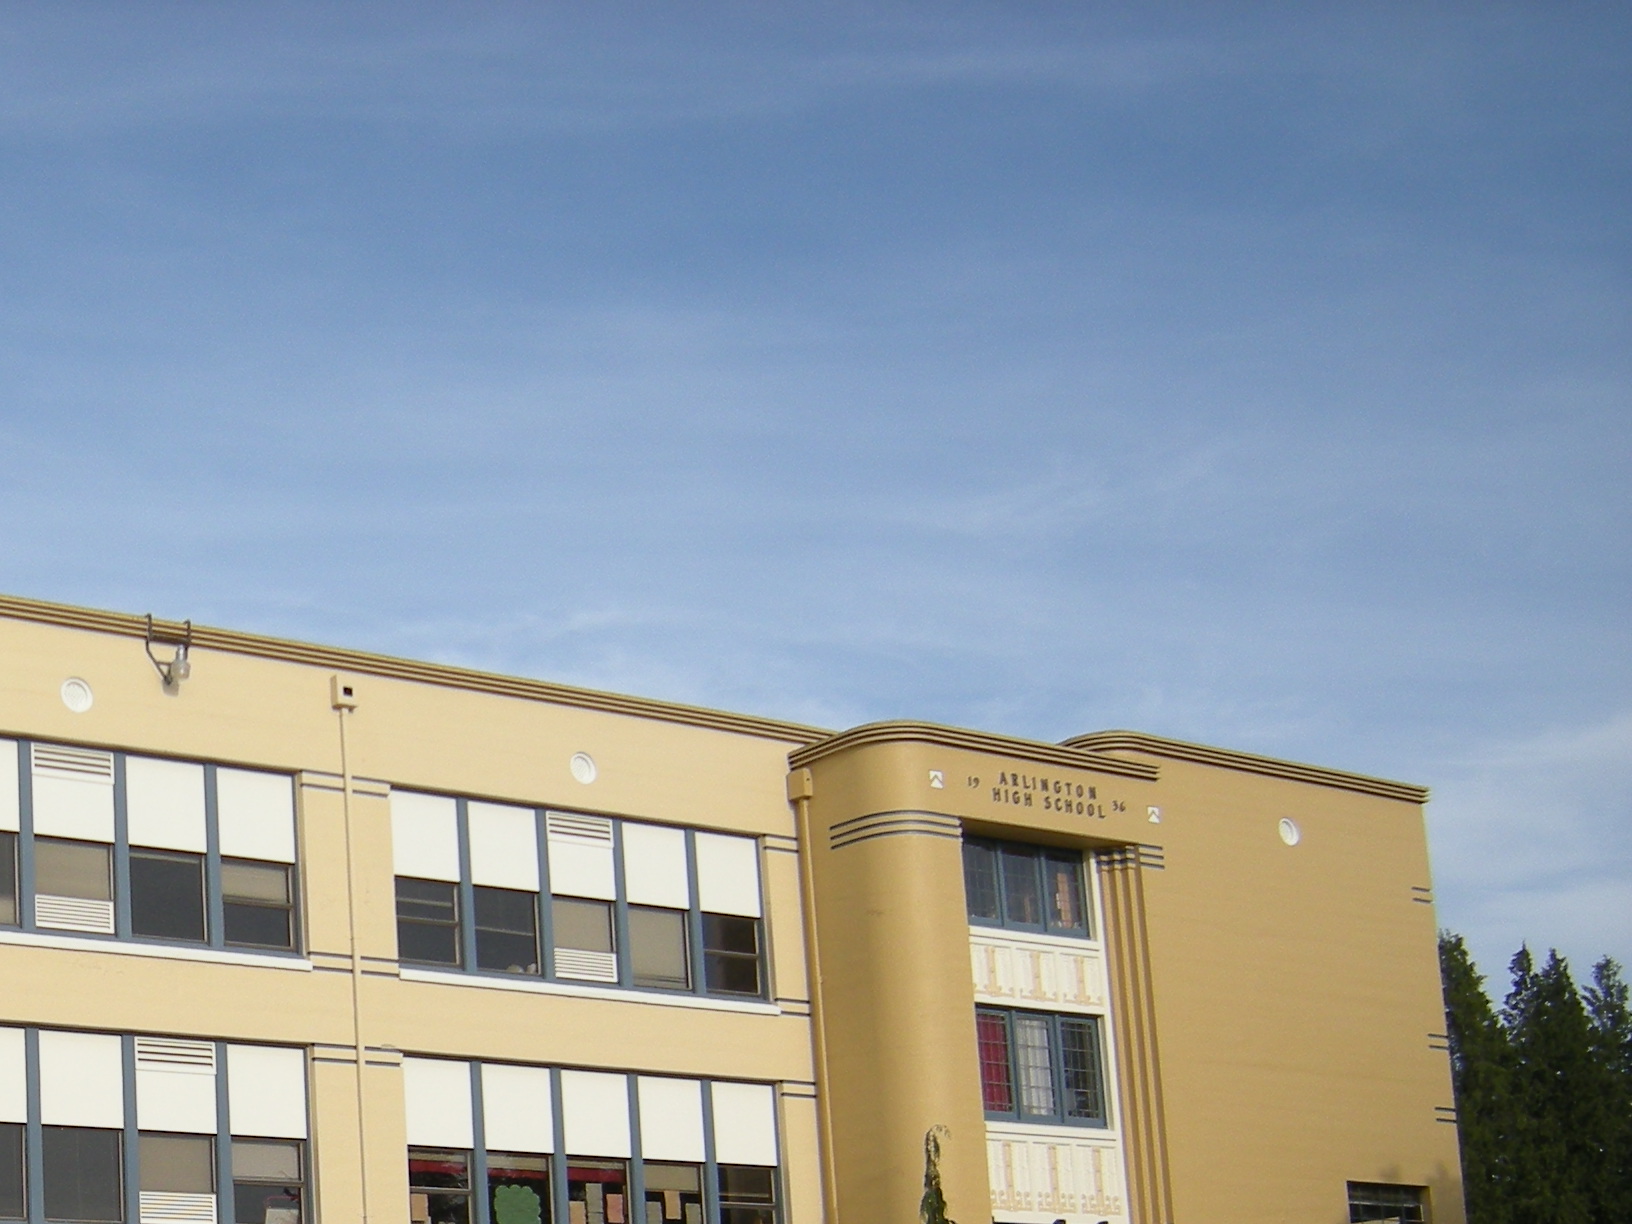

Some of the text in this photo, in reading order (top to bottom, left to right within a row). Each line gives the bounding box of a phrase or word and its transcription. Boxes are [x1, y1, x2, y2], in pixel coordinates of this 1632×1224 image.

[967, 776, 980, 789] 19
[999, 771, 1097, 800] ARLINGTON
[992, 787, 1107, 819] HIGH SCHOOL
[1112, 800, 1126, 812] 36
